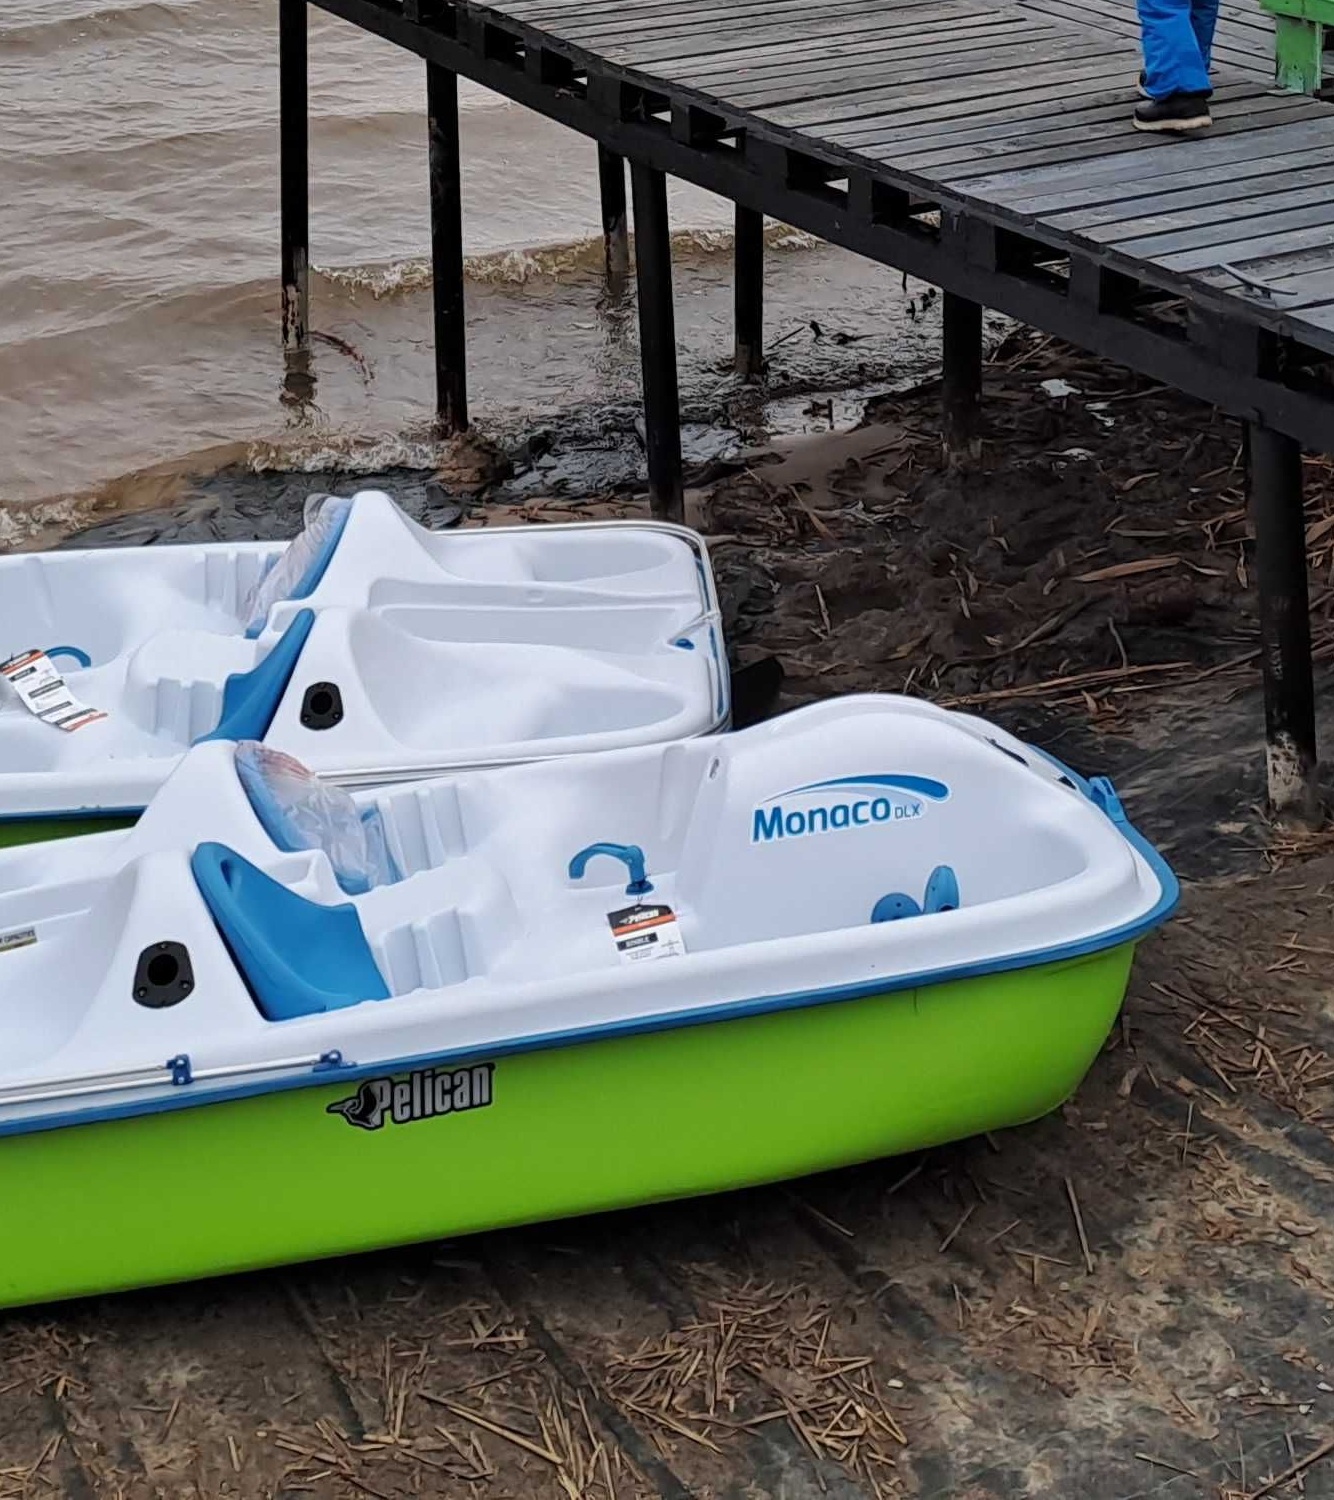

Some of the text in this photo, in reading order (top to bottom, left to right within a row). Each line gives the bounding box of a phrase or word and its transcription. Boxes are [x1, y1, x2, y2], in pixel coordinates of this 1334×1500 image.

[752, 797, 921, 842] Monaco DLX
[367, 1064, 493, 1128] Pelican
